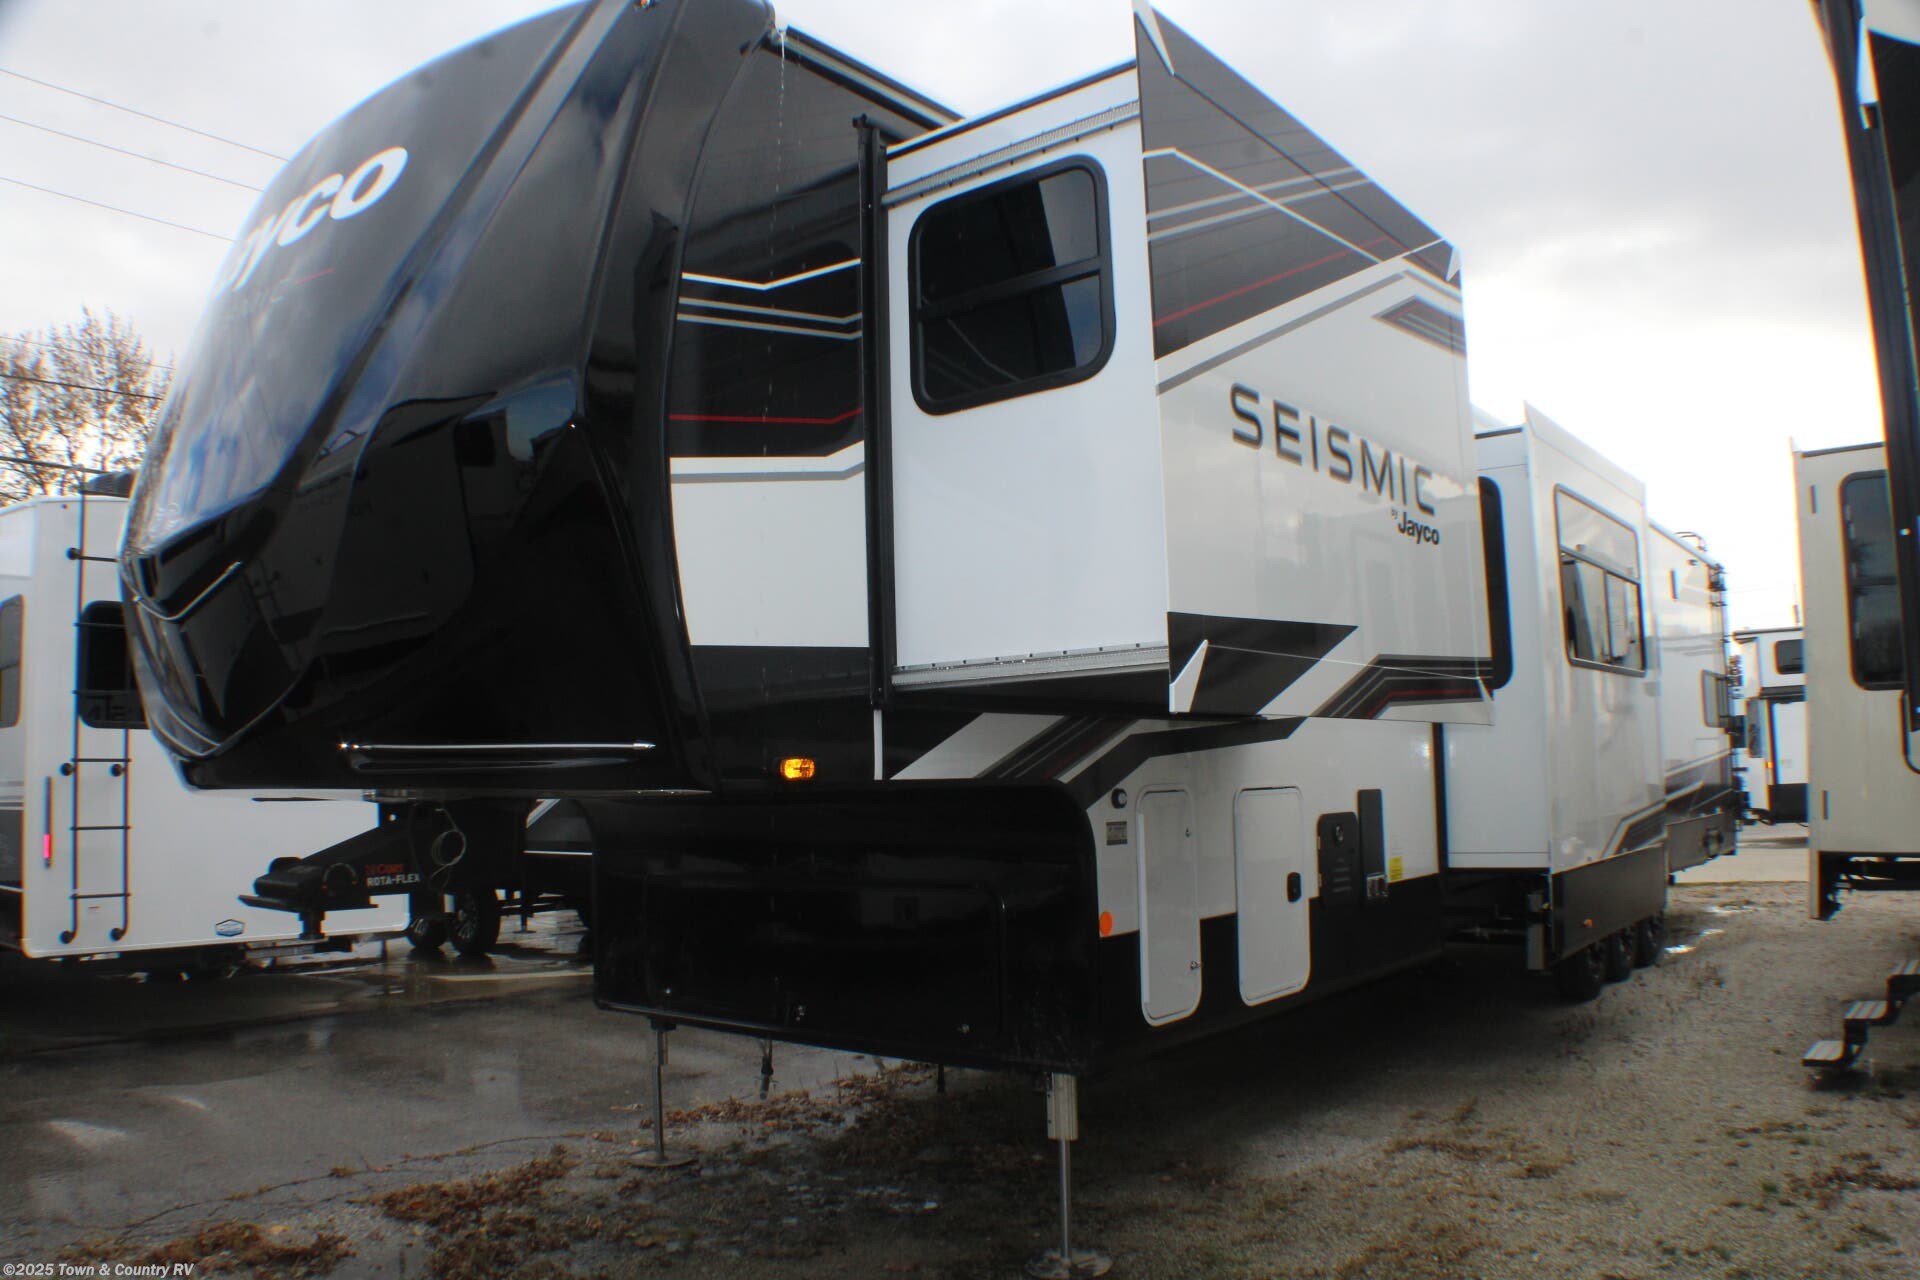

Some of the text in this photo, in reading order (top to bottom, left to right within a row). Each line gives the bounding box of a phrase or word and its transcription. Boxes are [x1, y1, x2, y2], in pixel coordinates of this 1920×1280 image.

[1230, 382, 1436, 516] SEISMIC
[1398, 511, 1440, 545] Jayco
[367, 873, 420, 886] ROTA-FLEX
